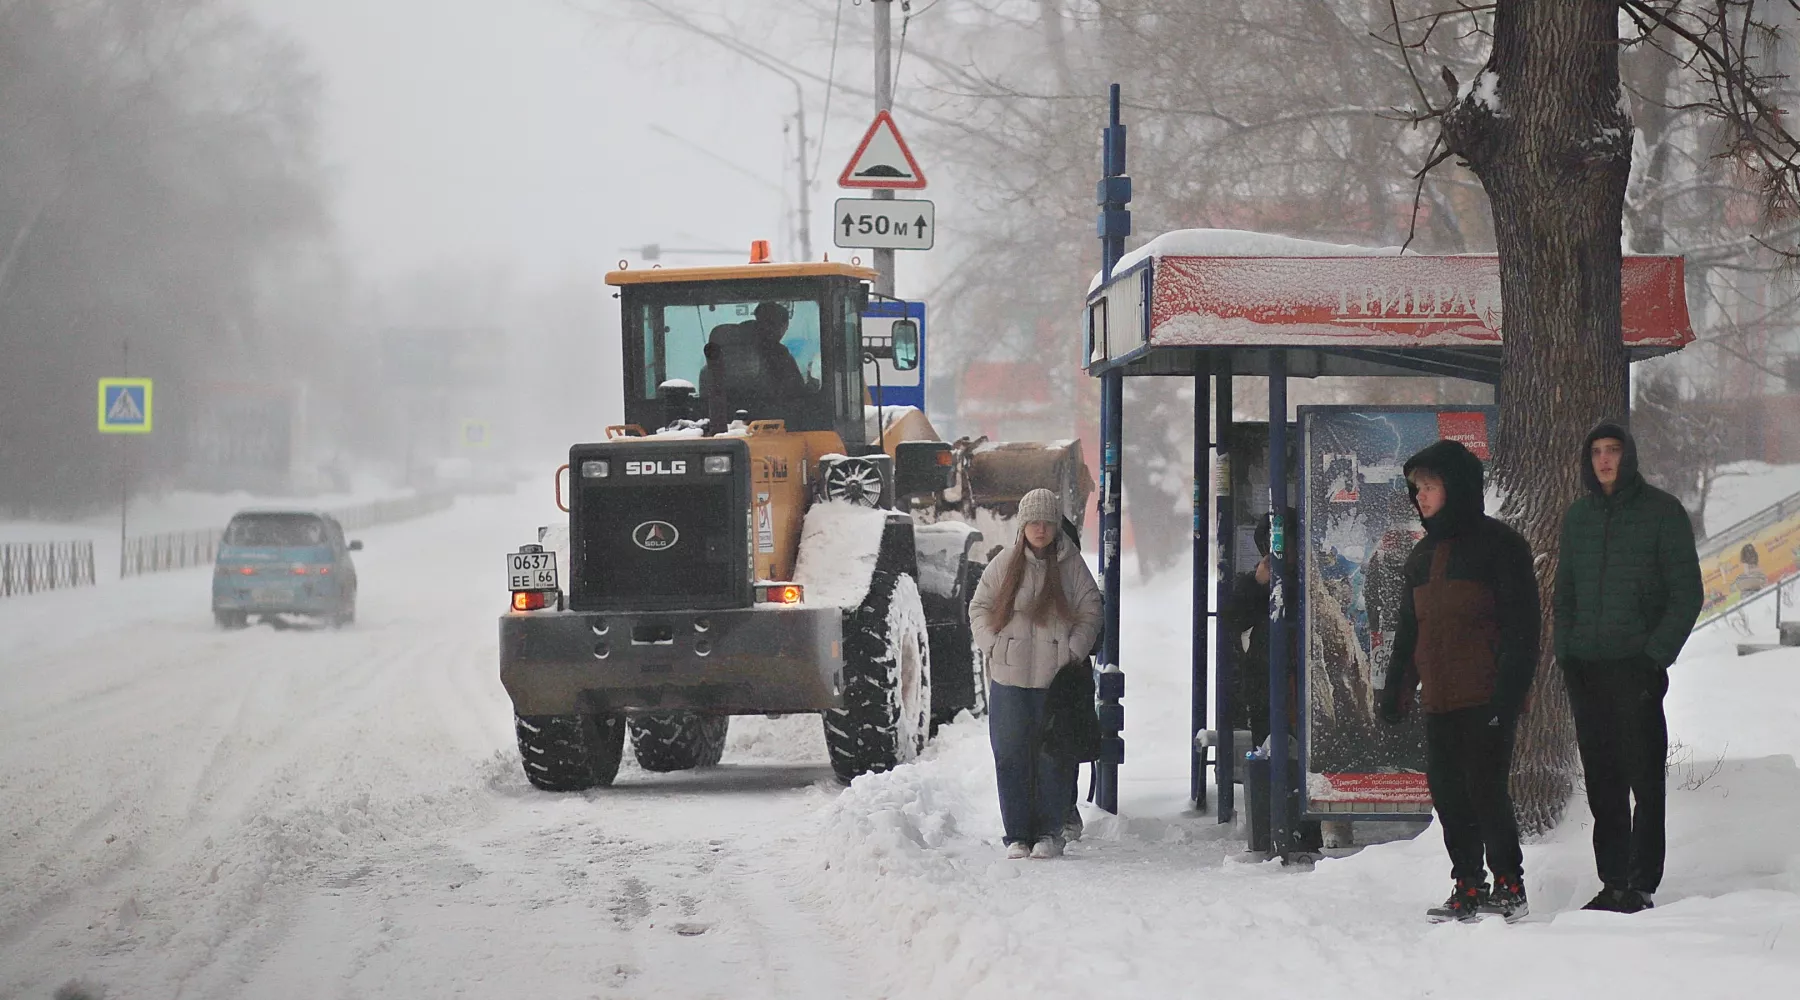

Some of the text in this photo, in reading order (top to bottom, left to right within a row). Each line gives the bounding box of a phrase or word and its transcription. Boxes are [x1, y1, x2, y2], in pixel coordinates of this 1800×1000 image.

[858, 214, 890, 235] 50
[626, 461, 686, 475] SDLG
[514, 555, 549, 570] 0637
[538, 571, 552, 582] 66
